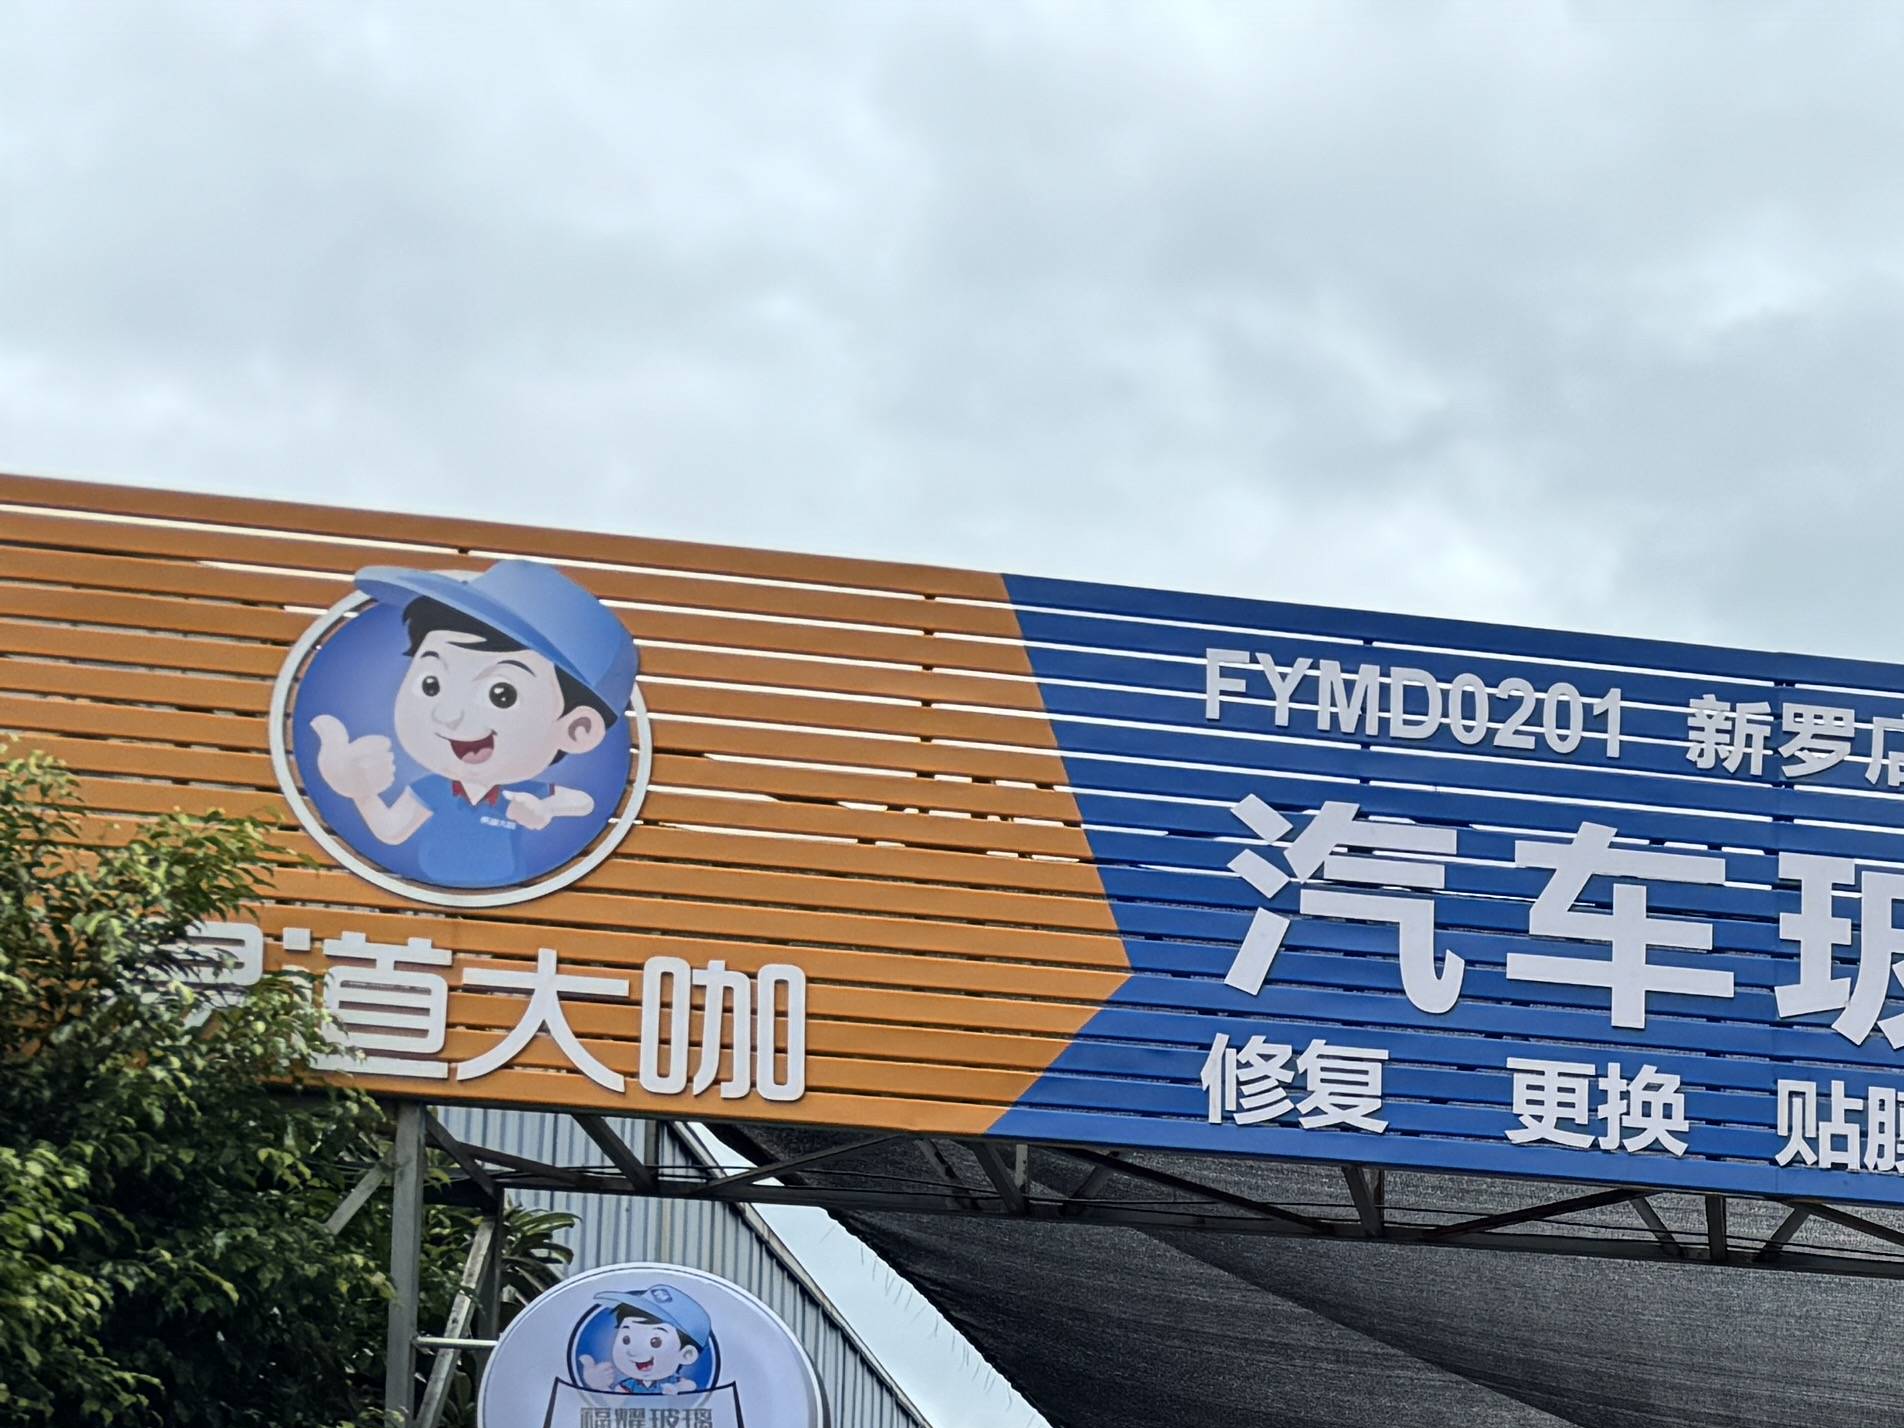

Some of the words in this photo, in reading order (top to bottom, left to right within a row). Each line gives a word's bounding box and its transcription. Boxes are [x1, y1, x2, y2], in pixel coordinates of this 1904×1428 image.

[1203, 647, 1622, 758] FYMD0201
[1200, 1032, 1390, 1134] 修复
[1505, 1056, 1690, 1158] 更换
